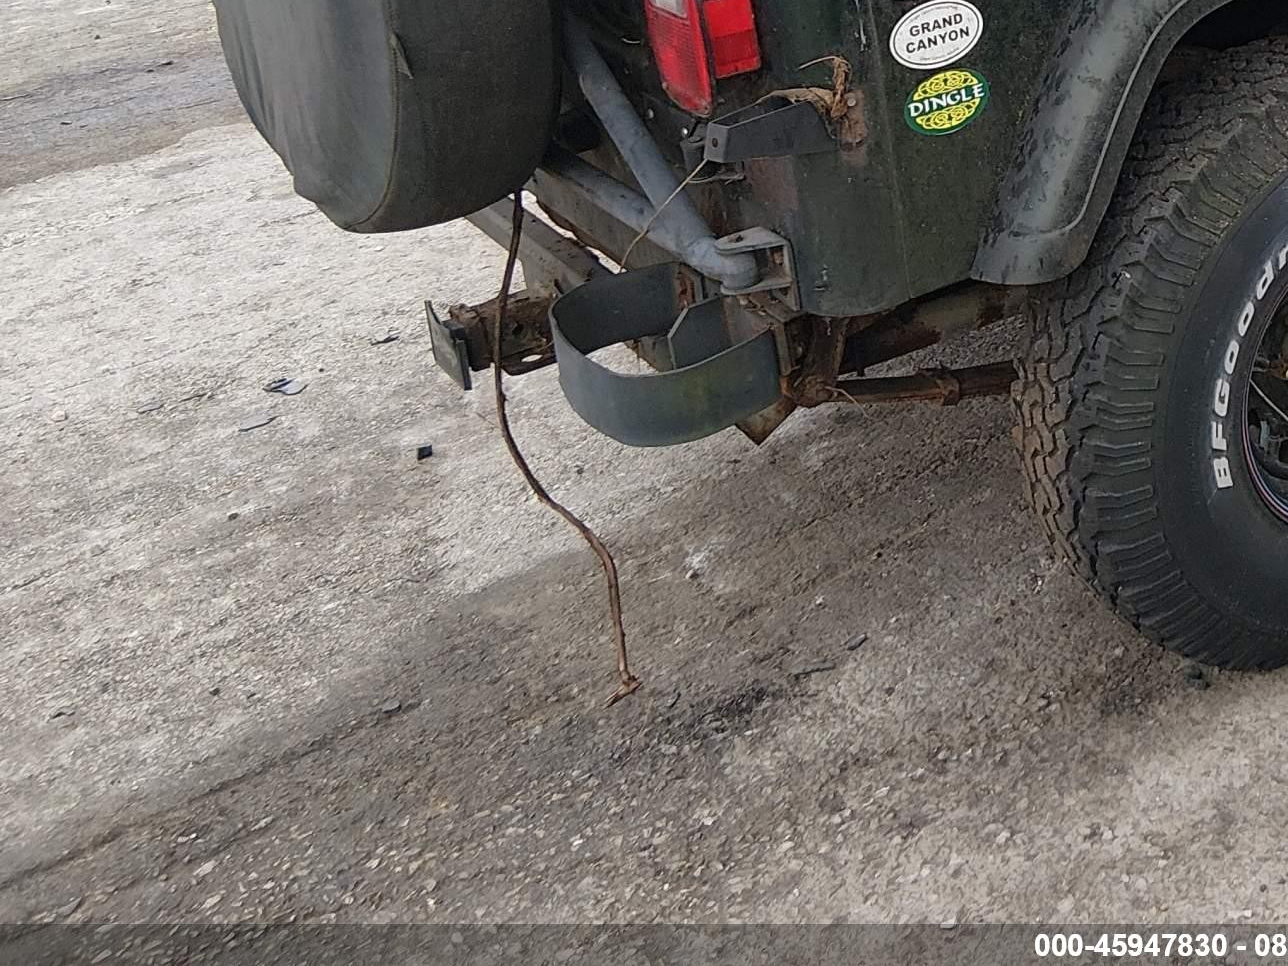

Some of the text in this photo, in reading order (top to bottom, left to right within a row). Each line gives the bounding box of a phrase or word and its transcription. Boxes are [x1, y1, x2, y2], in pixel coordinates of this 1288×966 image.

[906, 25, 970, 54] CANYON
[909, 13, 963, 37] GRAND
[908, 82, 985, 117] DINGLE
